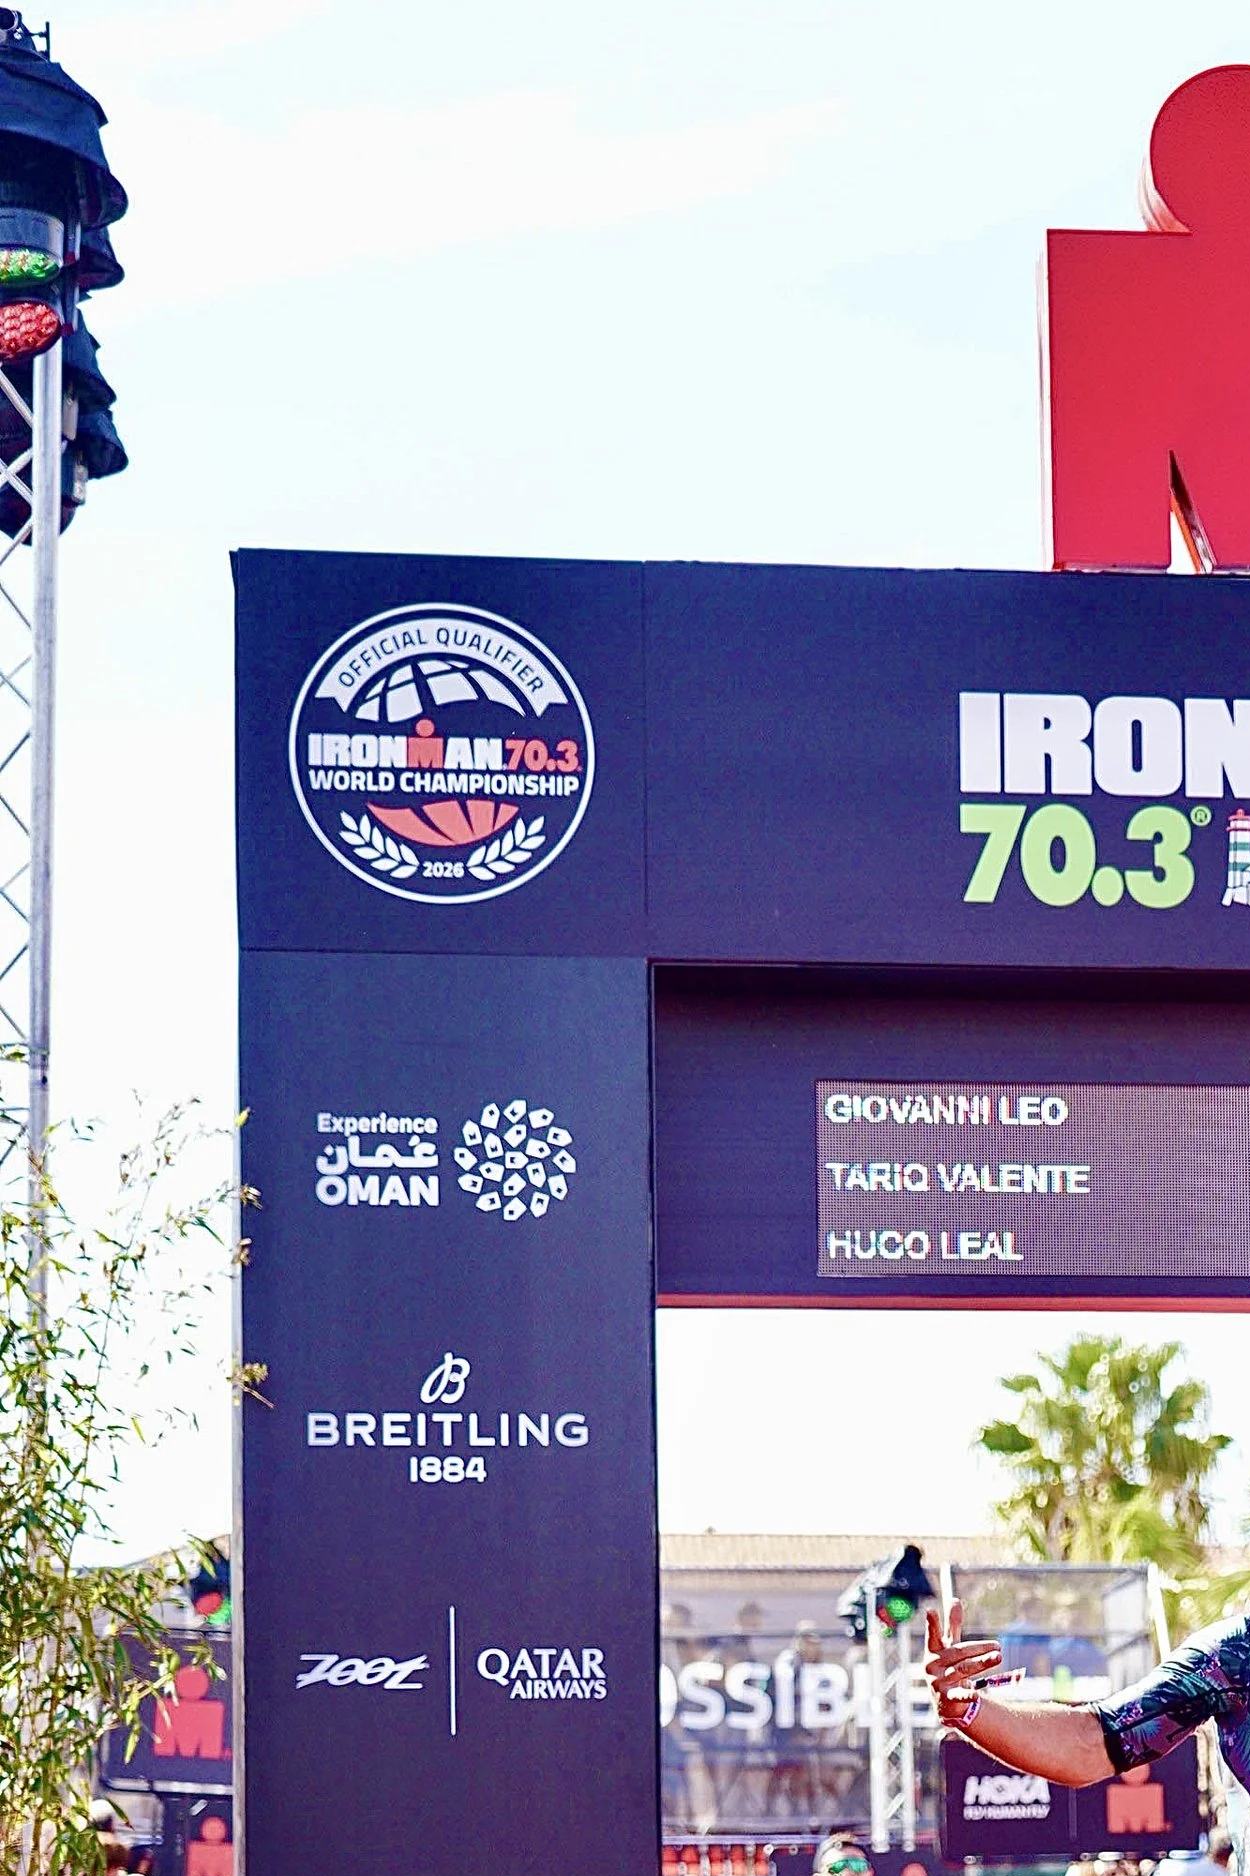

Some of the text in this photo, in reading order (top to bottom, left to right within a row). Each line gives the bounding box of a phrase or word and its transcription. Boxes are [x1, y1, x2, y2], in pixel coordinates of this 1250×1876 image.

[339, 627, 545, 694] OFFICIAL QUALIFIER
[308, 717, 580, 772] IRONMAN 70.3
[309, 769, 579, 797] WORLD CHAMPIONSHIP
[423, 861, 464, 879] 2026
[960, 804, 1194, 908] 70.3
[318, 1112, 438, 1137] Experience
[824, 1094, 990, 1126] GIOVANNI
[1000, 1097, 1068, 1126] LEO
[316, 1174, 440, 1206] OMAN
[825, 1161, 930, 1192] TARIQ
[937, 1164, 1091, 1193] VALENTE
[941, 1231, 1025, 1260] LEAL
[308, 1413, 589, 1447] BREITLING
[410, 1456, 487, 1483] 1884
[477, 1648, 606, 1685] QATAR
[510, 1679, 607, 1700] AIRWAYS
